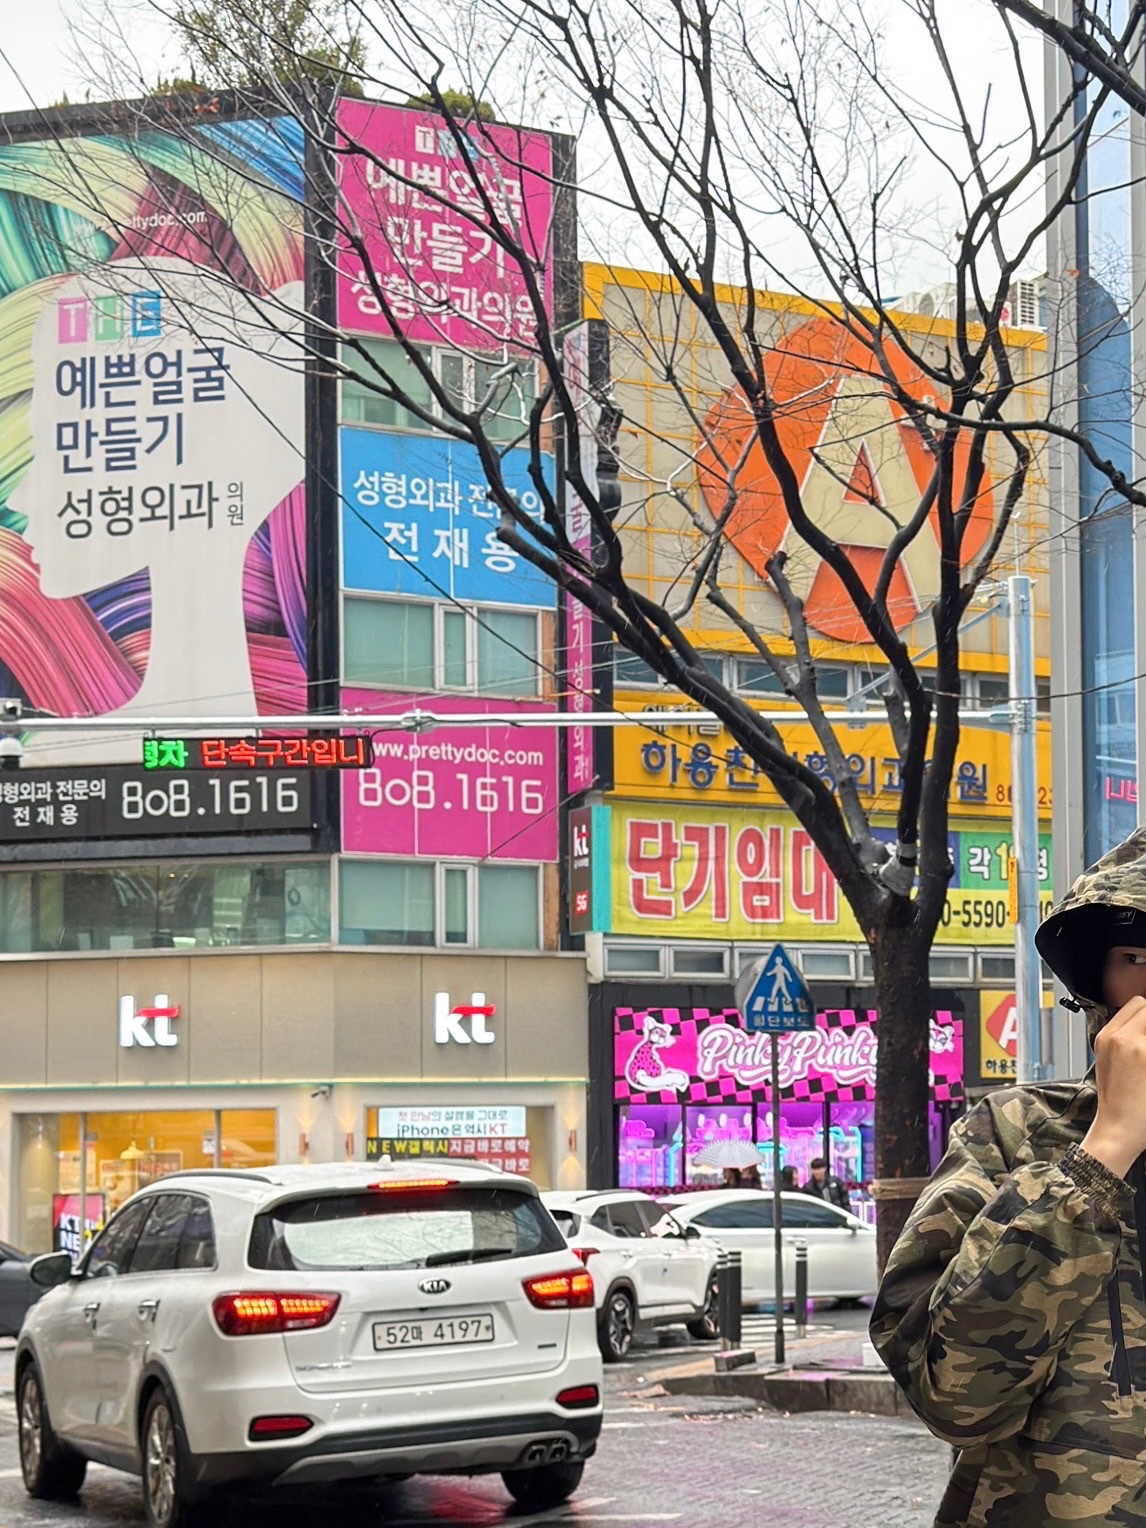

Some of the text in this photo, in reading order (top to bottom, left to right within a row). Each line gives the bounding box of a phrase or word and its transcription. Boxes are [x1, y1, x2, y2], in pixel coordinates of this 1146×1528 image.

[387, 216, 505, 279] 만들기
[63, 299, 159, 338] THE
[56, 347, 231, 410] 예쁜얼굴
[56, 412, 184, 474] 만들기
[57, 481, 220, 539] 성형외과
[227, 481, 244, 526] 의원
[353, 470, 462, 515] 성형외과
[202, 737, 364, 767] 단속구간입니
[372, 742, 545, 766] ww.prettydoc.com
[0, 779, 106, 804] 형외과 전문의
[627, 820, 840, 923] 단기임대
[120, 995, 180, 1046] kt
[434, 993, 496, 1044] kt
[423, 1282, 447, 1293] KIA
[386, 1320, 482, 1345] 52마 4197
